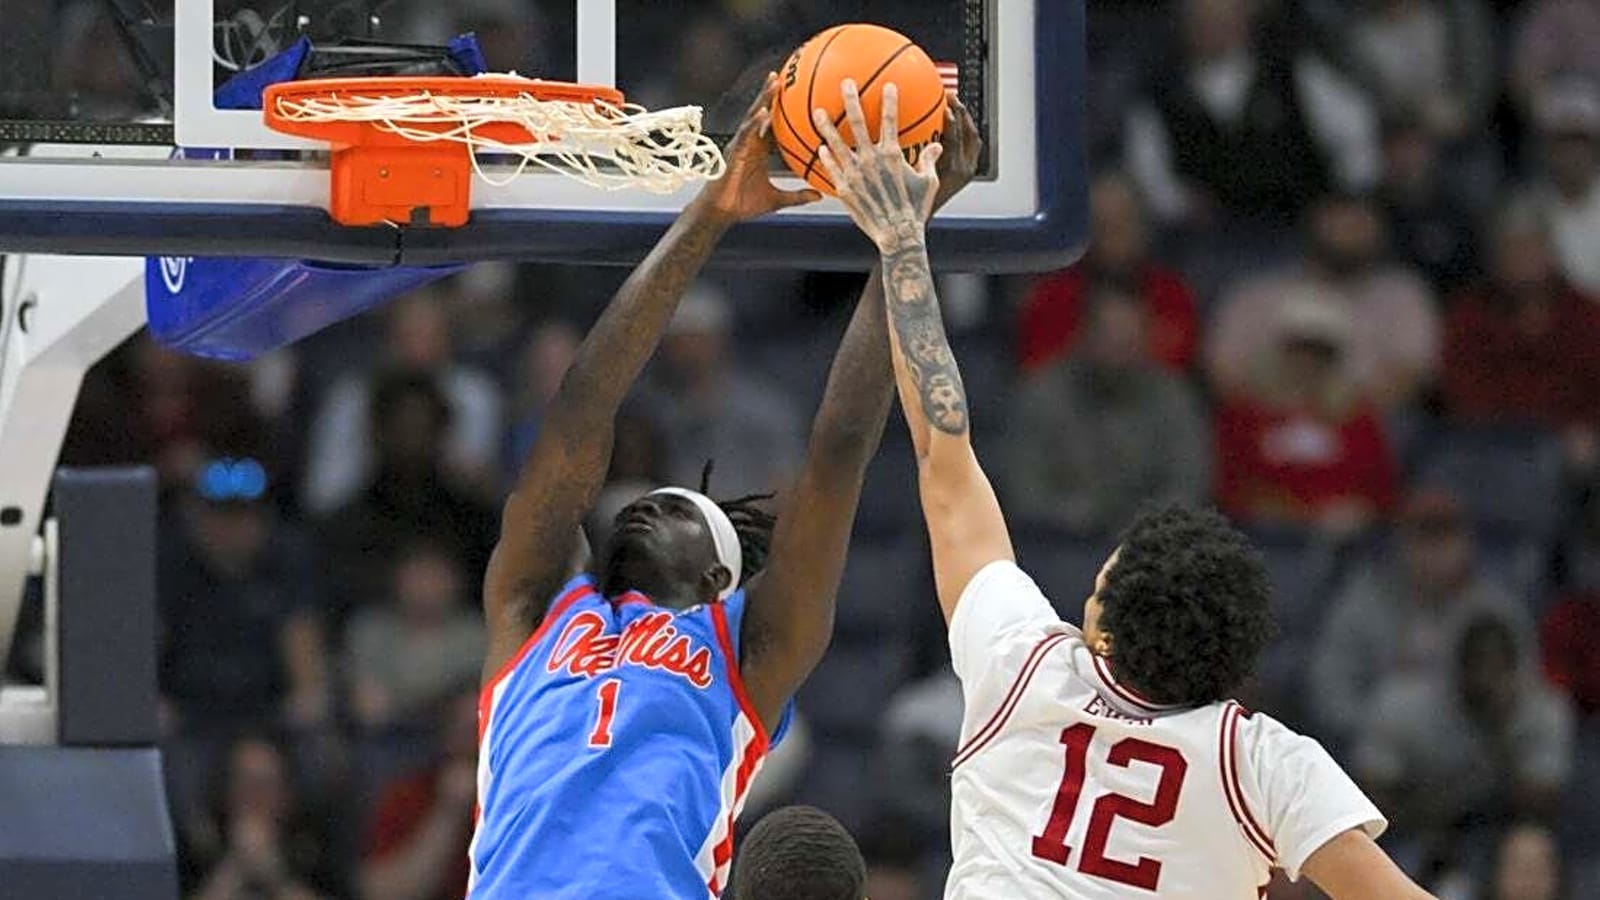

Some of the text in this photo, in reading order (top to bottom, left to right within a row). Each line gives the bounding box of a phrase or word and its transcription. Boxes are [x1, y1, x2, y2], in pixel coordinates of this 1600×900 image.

[615, 611, 713, 688] Miss
[588, 679, 621, 747] 1
[1031, 721, 1188, 892] 12
